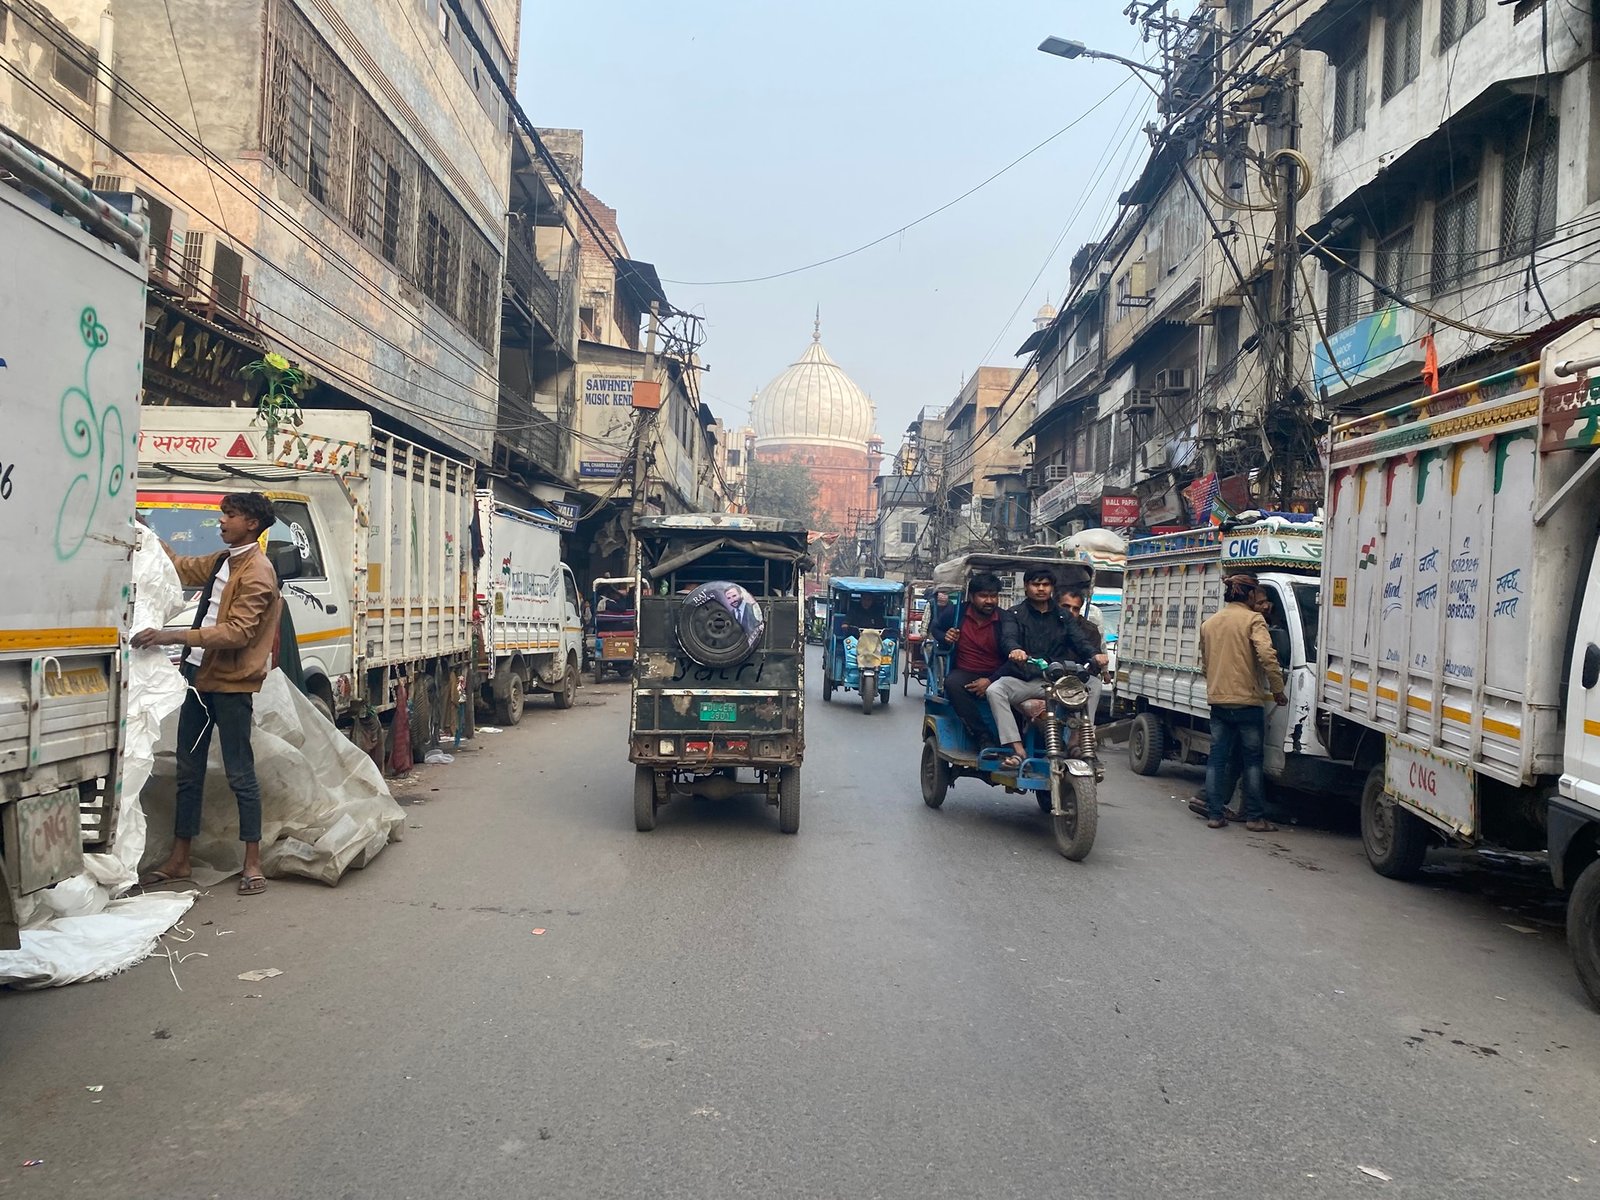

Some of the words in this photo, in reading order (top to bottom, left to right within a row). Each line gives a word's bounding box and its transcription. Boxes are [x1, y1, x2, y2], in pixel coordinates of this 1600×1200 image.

[586, 378, 633, 392] SAWHNEY
[585, 393, 610, 405] MUSIC
[612, 394, 633, 406] KEND
[153, 435, 222, 457] सरकार
[1105, 498, 1120, 506] WALL
[1229, 538, 1259, 558] CNG
[1493, 596, 1519, 619] भारत
[1409, 762, 1437, 796] CNG
[32, 804, 73, 863] CNG
